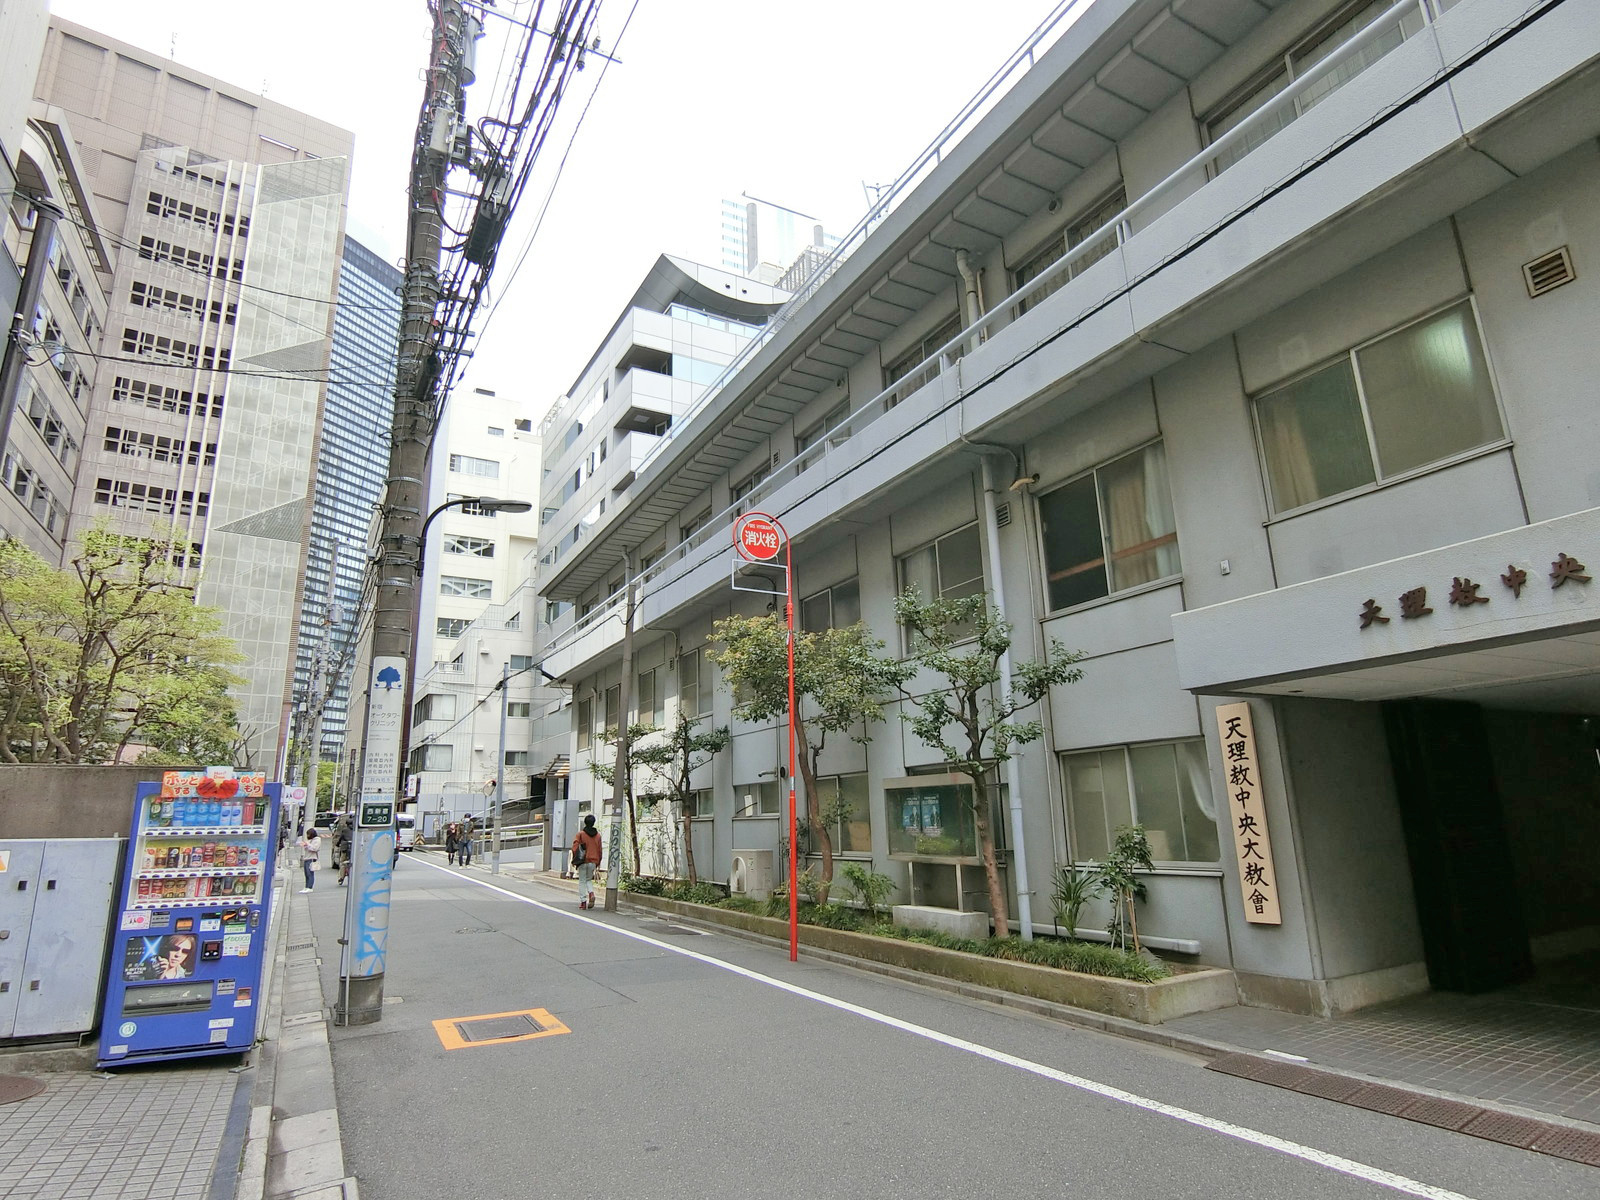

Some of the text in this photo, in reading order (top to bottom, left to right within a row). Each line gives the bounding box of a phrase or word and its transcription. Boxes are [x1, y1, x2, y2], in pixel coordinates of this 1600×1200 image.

[745, 530, 777, 548] 消火栓
[1359, 552, 1594, 631] 天理教中央
[166, 775, 199, 787] ホッと
[240, 776, 257, 784] ぬく
[173, 787, 190, 795] する
[244, 785, 261, 793] もり
[1224, 716, 1270, 915] 天理教中央大教會
